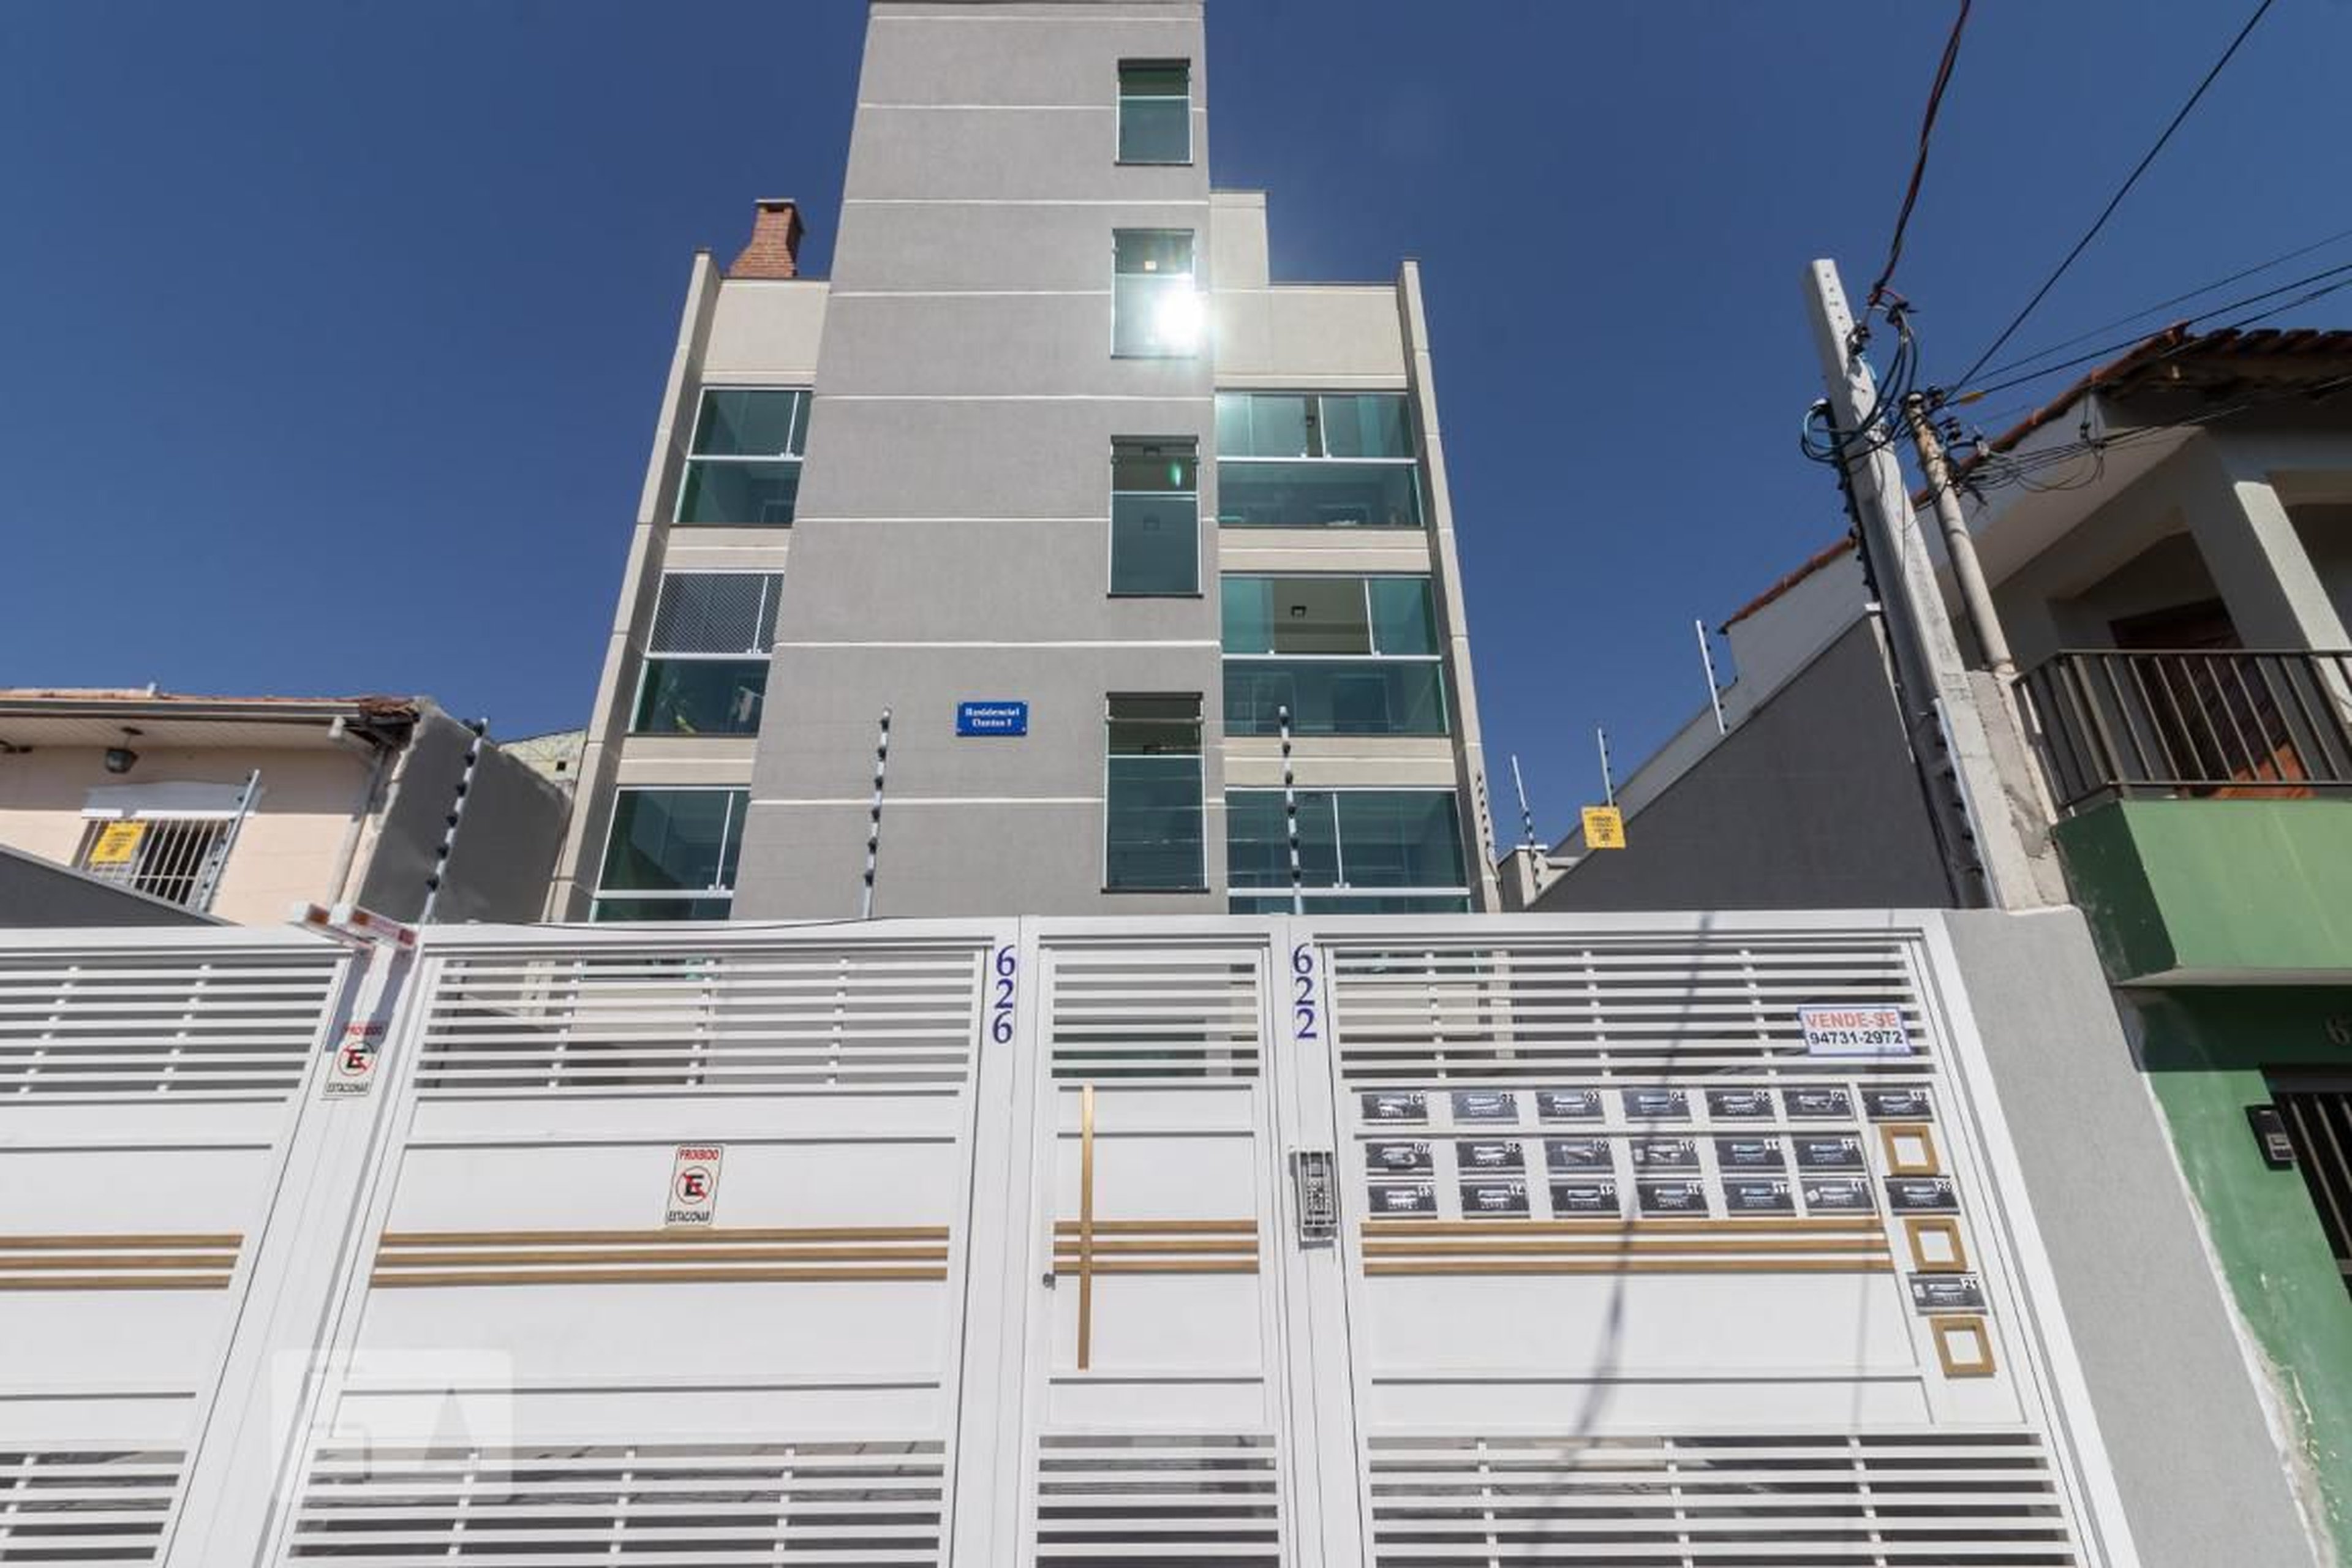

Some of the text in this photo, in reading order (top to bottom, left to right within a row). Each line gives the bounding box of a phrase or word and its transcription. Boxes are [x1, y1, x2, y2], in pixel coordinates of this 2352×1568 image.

[965, 707, 1020, 717] Residencial
[992, 944, 1017, 1043] 626
[1292, 943, 1317, 1039] 622
[1807, 1012, 1896, 1028] VENDE-SE
[1809, 1030, 1904, 1044] 94731-2972
[679, 1148, 719, 1160] PROIBIDO
